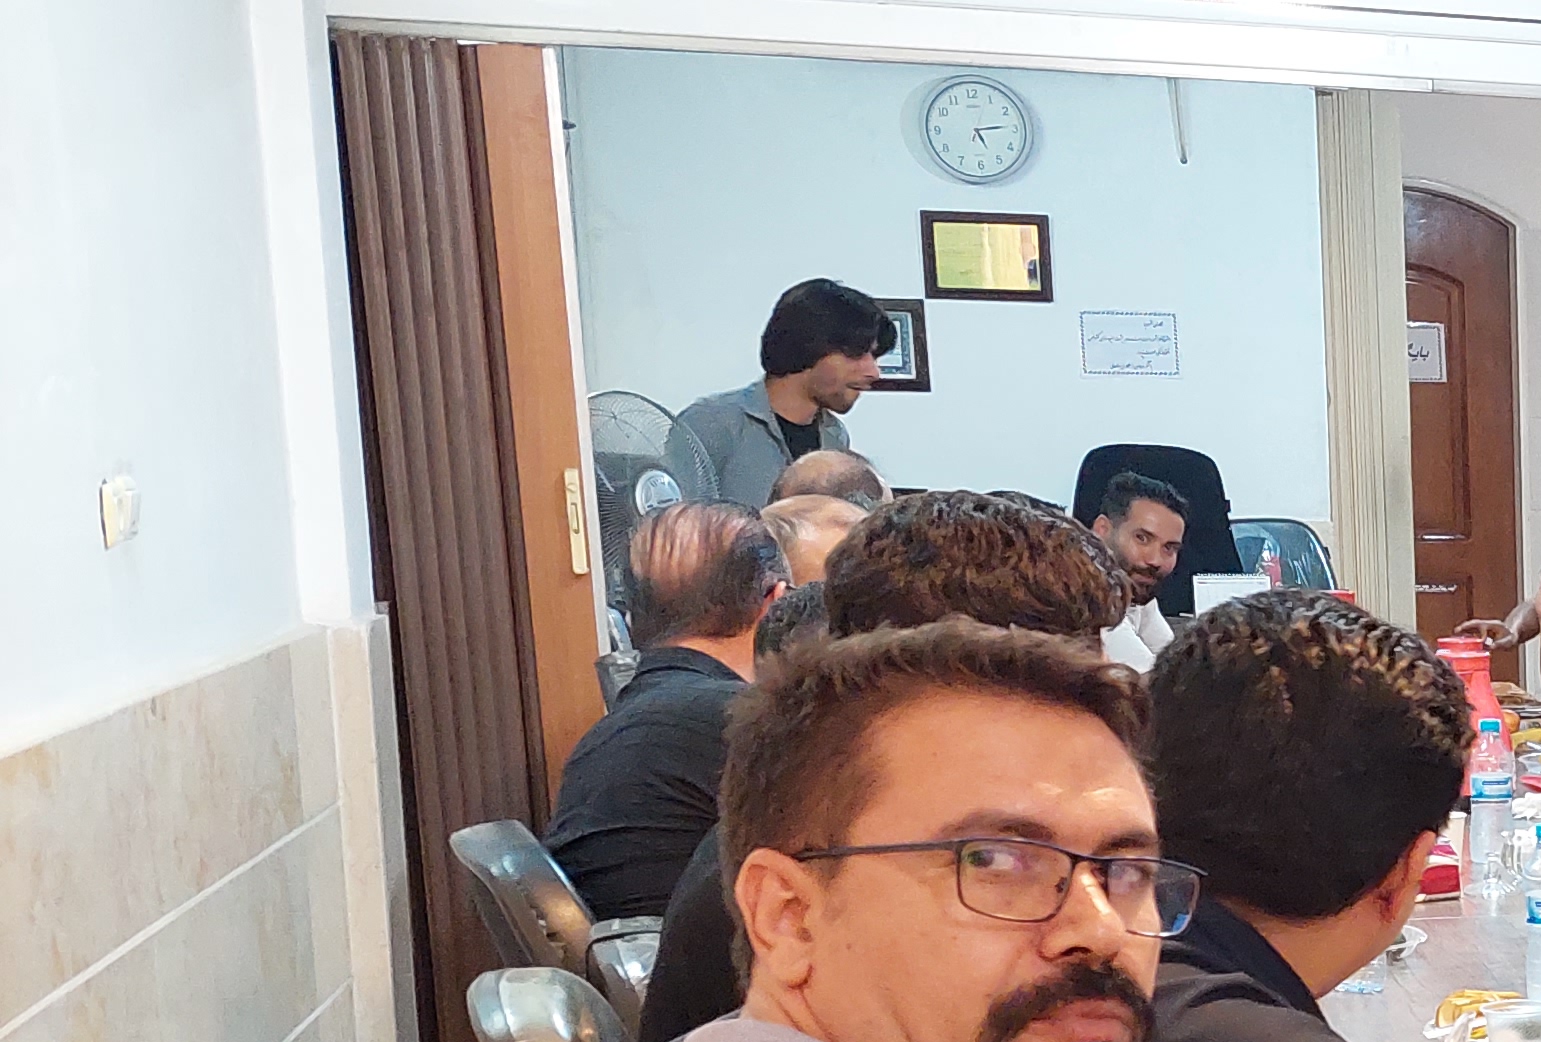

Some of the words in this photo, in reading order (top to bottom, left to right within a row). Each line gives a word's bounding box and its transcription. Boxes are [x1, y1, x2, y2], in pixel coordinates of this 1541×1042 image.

[966, 89, 978, 99] 12
[949, 95, 959, 105] 11
[988, 95, 993, 104] 1
[938, 107, 948, 117] 10
[1002, 106, 1009, 116] 2
[934, 125, 941, 135] 9
[1012, 125, 1018, 134] 3
[943, 143, 949, 153] 8
[1007, 142, 1014, 151] 4
[958, 155, 965, 165] 7
[996, 154, 1002, 165] 5
[978, 160, 985, 170] 6
